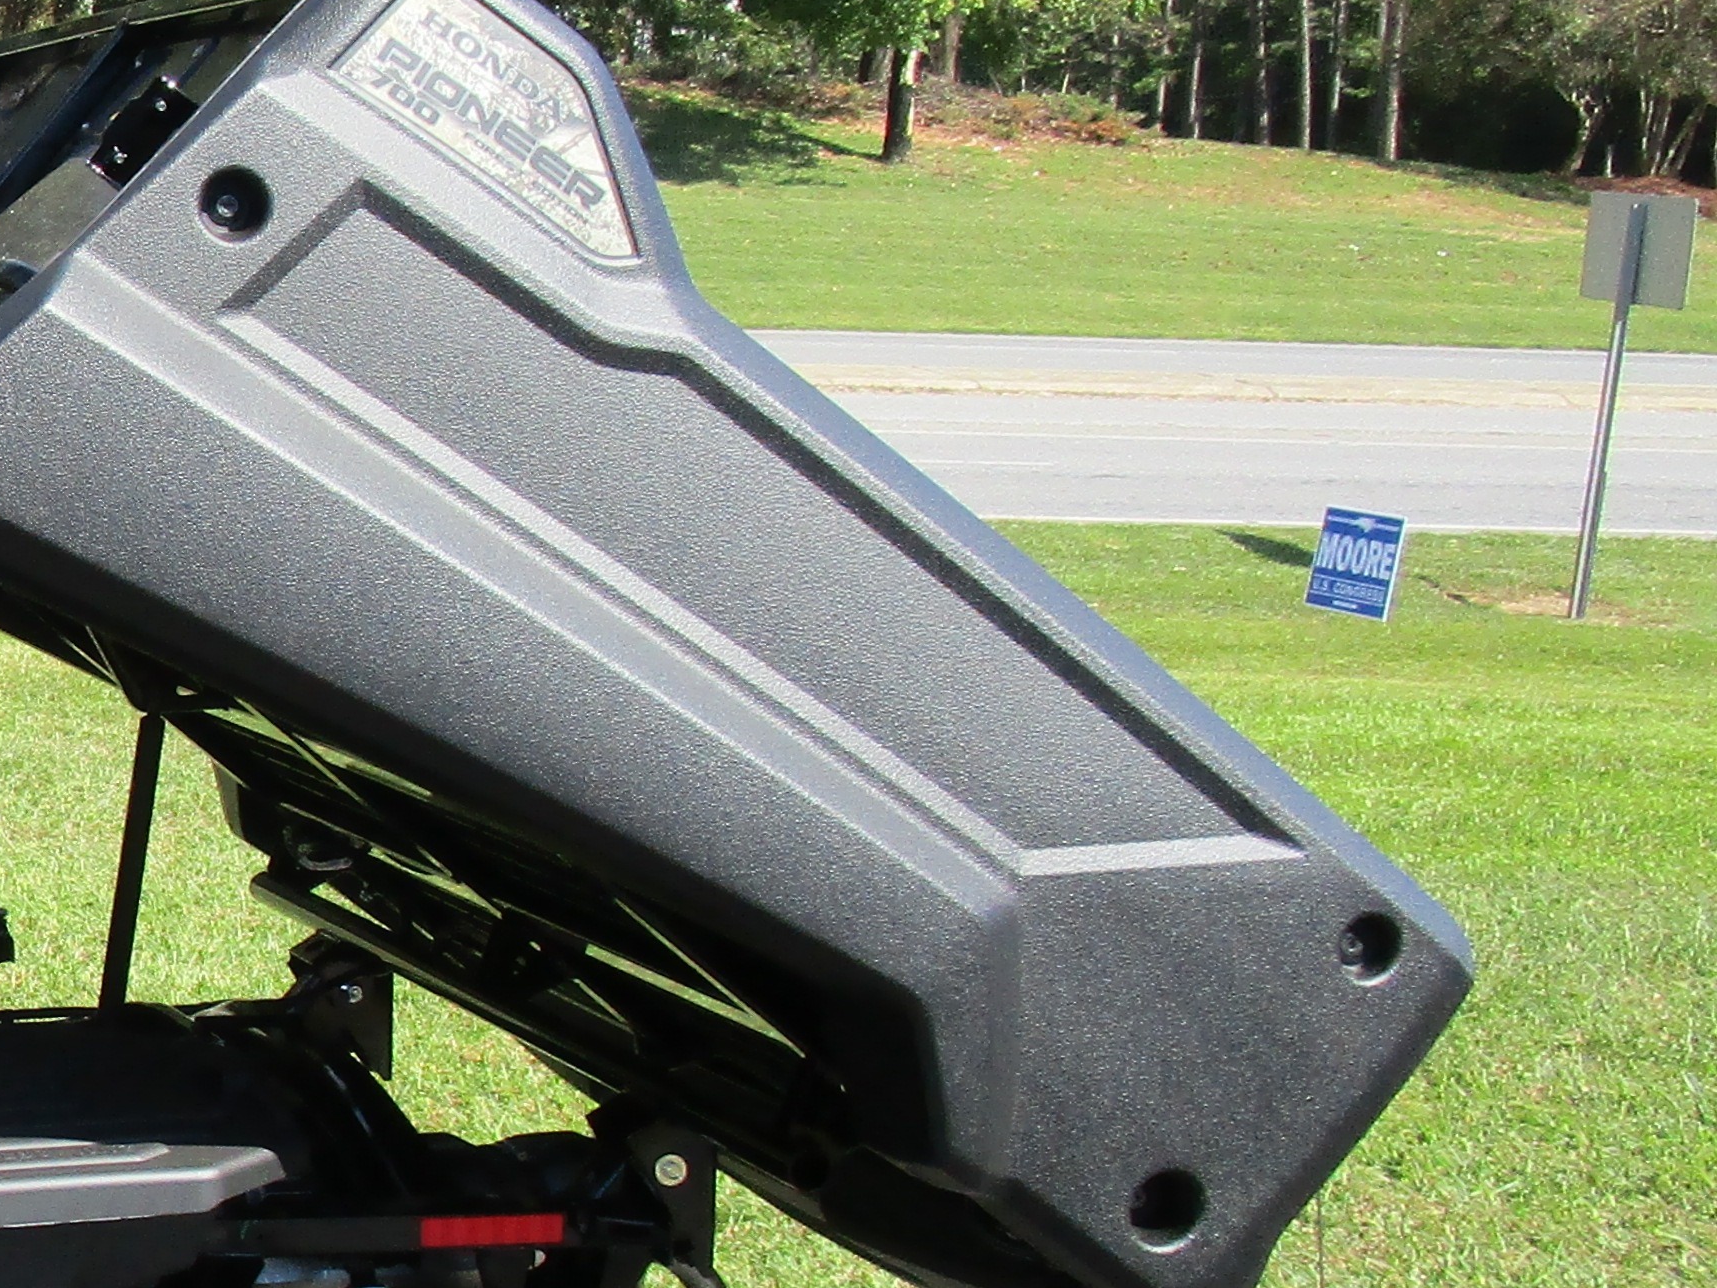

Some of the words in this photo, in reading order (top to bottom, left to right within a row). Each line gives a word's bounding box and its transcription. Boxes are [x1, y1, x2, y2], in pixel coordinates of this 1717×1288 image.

[370, 69, 440, 125] 700
[420, 9, 564, 121] HONDA
[378, 38, 606, 209] PIONEER
[1317, 532, 1396, 579] MOORE
